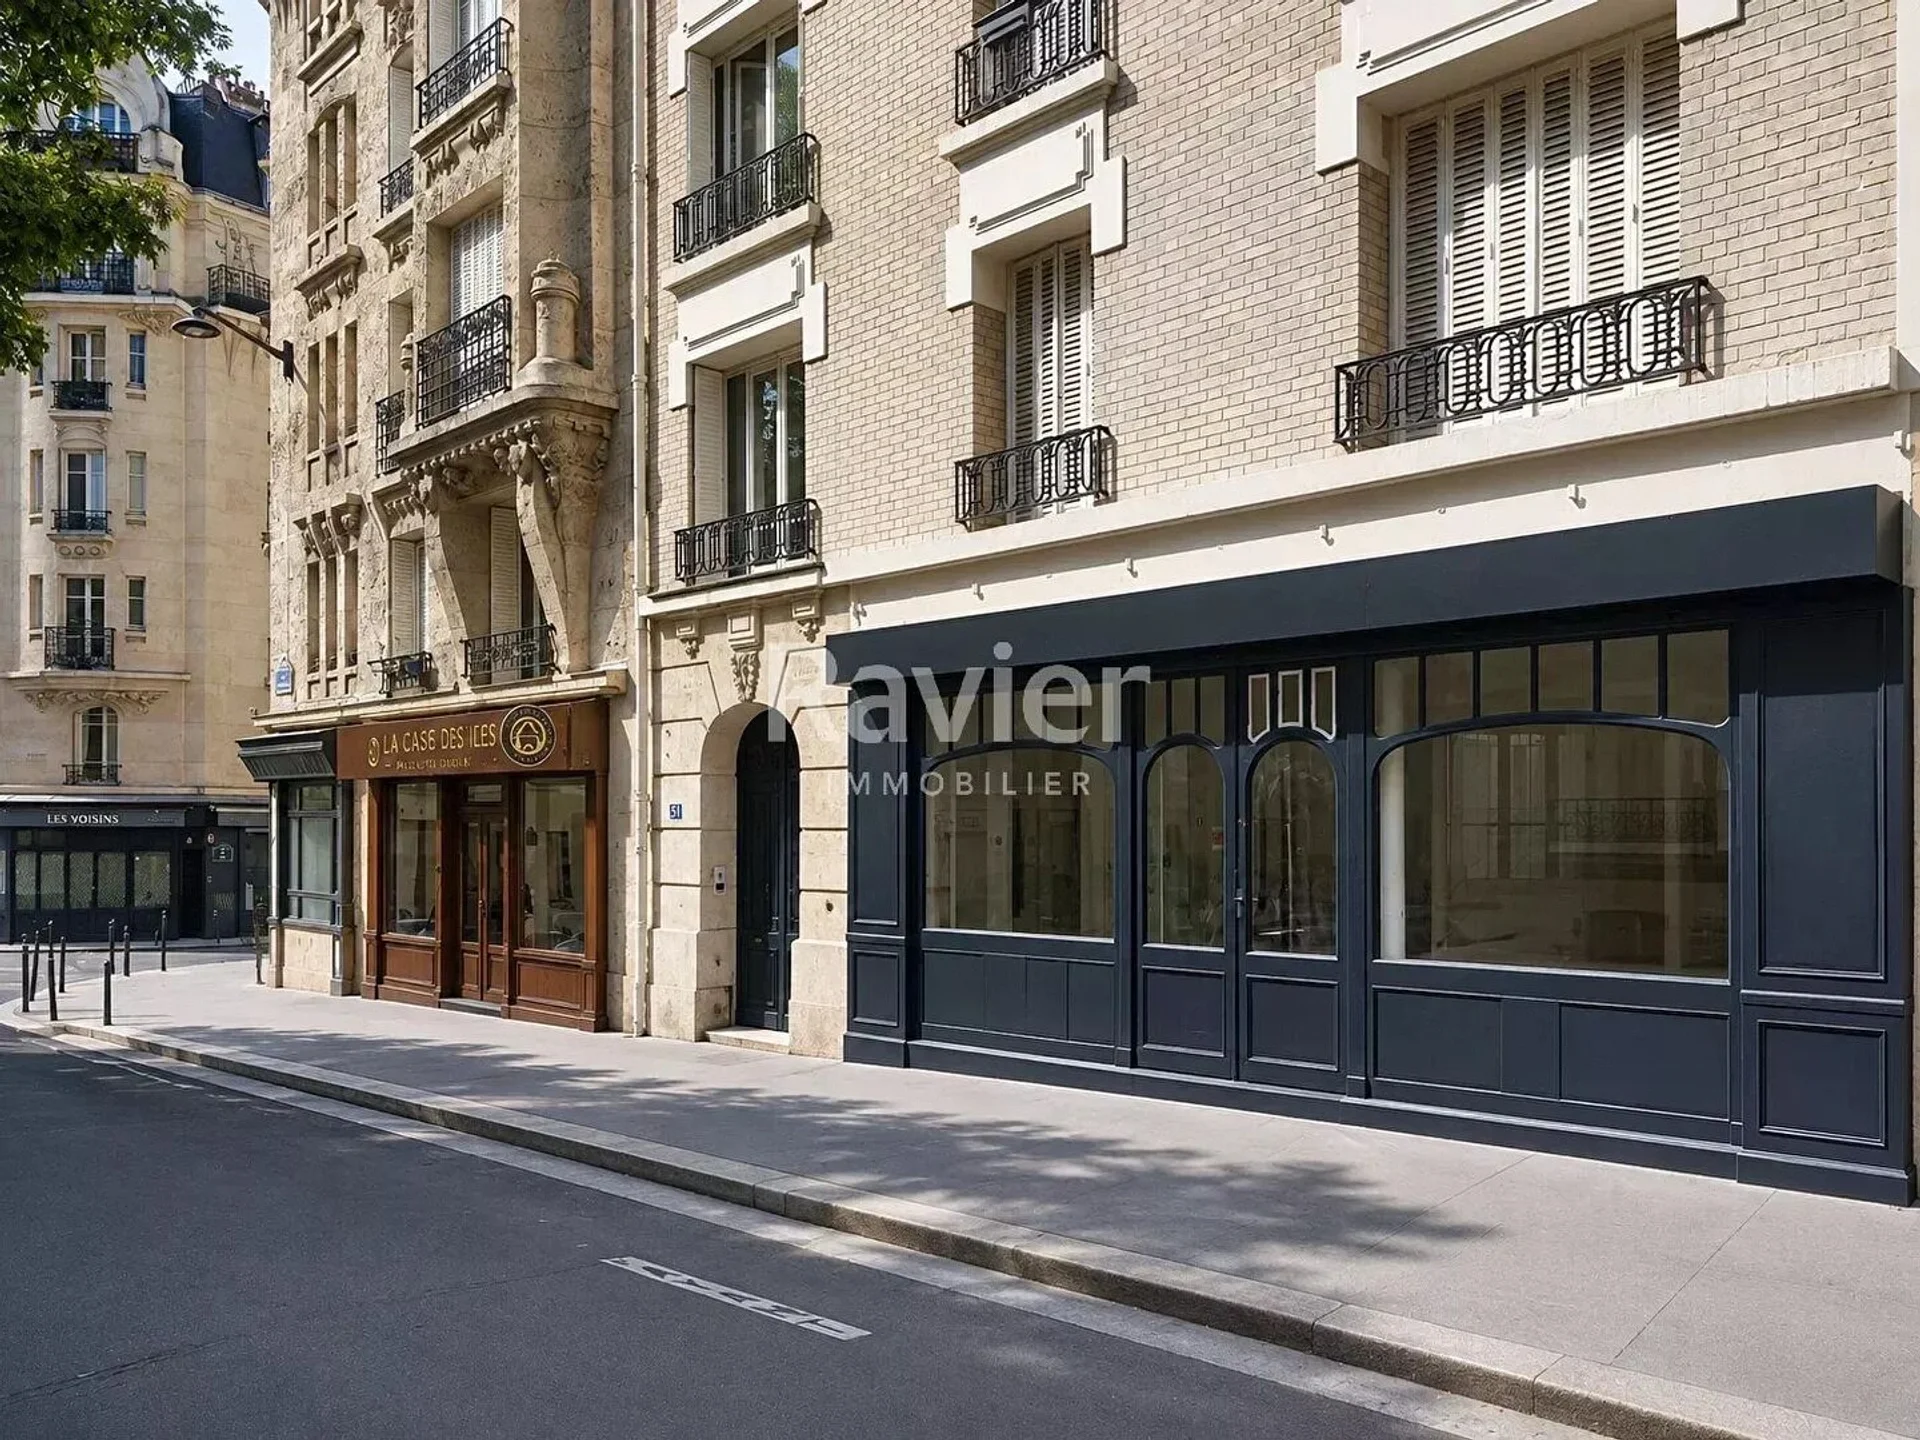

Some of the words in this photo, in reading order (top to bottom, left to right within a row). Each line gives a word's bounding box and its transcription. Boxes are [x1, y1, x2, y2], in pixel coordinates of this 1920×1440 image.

[383, 733, 399, 754] LA
[441, 727, 464, 750] DES
[47, 814, 67, 824] LES
[71, 814, 119, 824] VOISINS
[670, 804, 680, 819] 51
